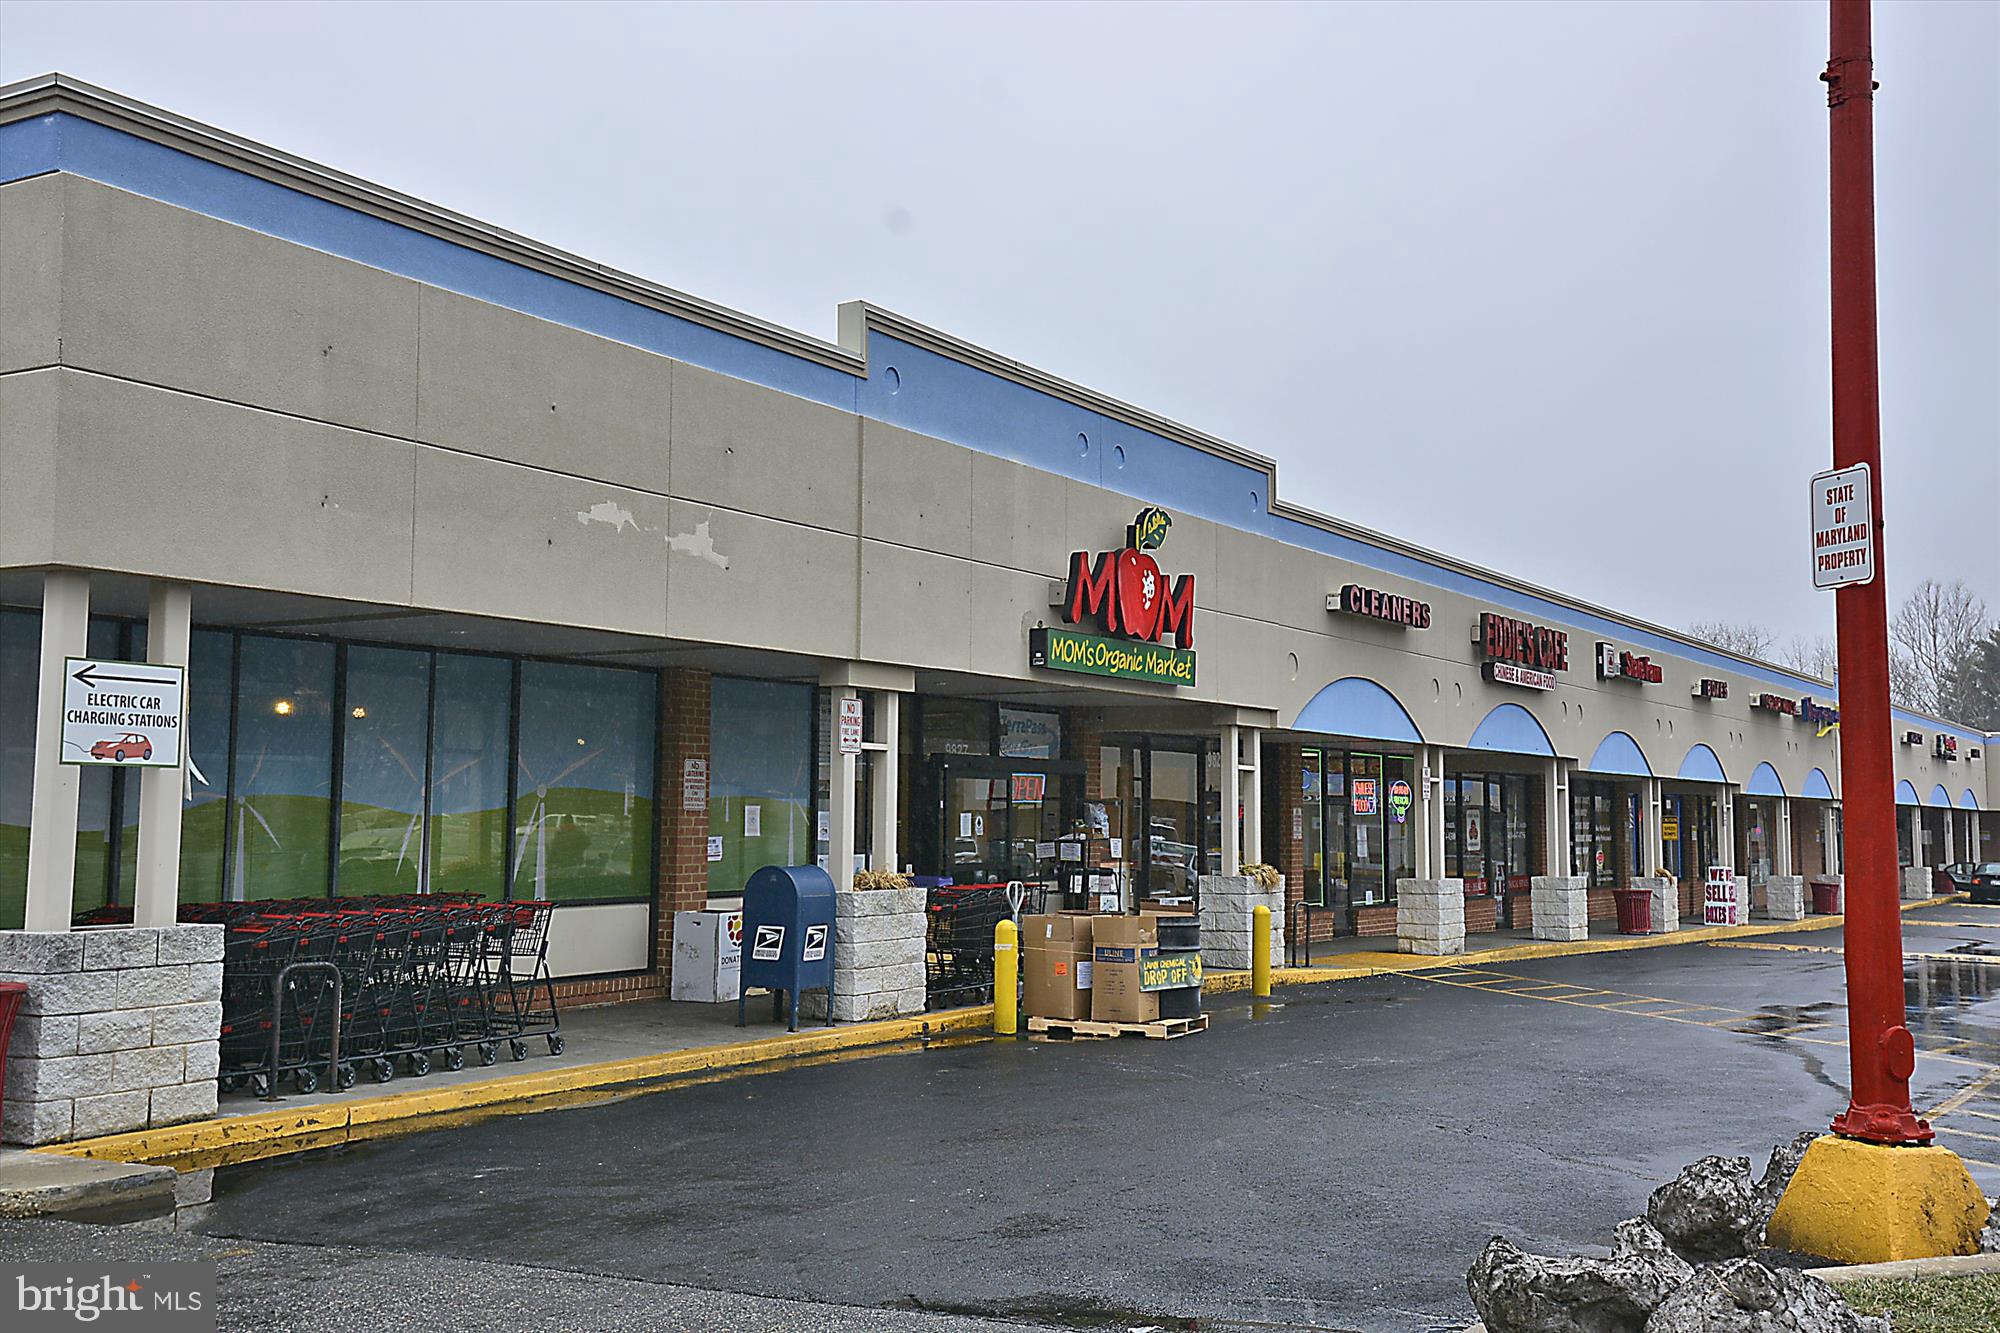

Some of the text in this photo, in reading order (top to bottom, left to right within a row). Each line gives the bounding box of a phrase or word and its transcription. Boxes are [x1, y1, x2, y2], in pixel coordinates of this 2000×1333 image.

[1826, 484, 1854, 505] STATE
[1834, 506, 1846, 524] OF
[1815, 523, 1867, 548] MARYLAND
[1818, 547, 1867, 572] PROPERTY
[1071, 547, 1195, 650] MOM
[1349, 585, 1431, 629] CLEANERS
[1487, 613, 1569, 672] EDDIE'S CAFE
[1051, 637, 1192, 680] MOM's Organic Market
[1495, 664, 1515, 682] CHINESE
[1520, 670, 1543, 688] AMERICAN
[1543, 674, 1555, 690] FOOD
[87, 692, 161, 710] ELECTRIC CAR
[847, 703, 856, 714] NO
[67, 709, 178, 729] CHARGING STATIONS
[841, 715, 861, 727] PARKING
[691, 761, 700, 770] NO
[1710, 868, 1724, 882] WE
[1705, 884, 1728, 903] SELL
[1705, 905, 1727, 924] BOXES
[1144, 969, 1168, 986] DROP
[1171, 968, 1187, 983] OFF
